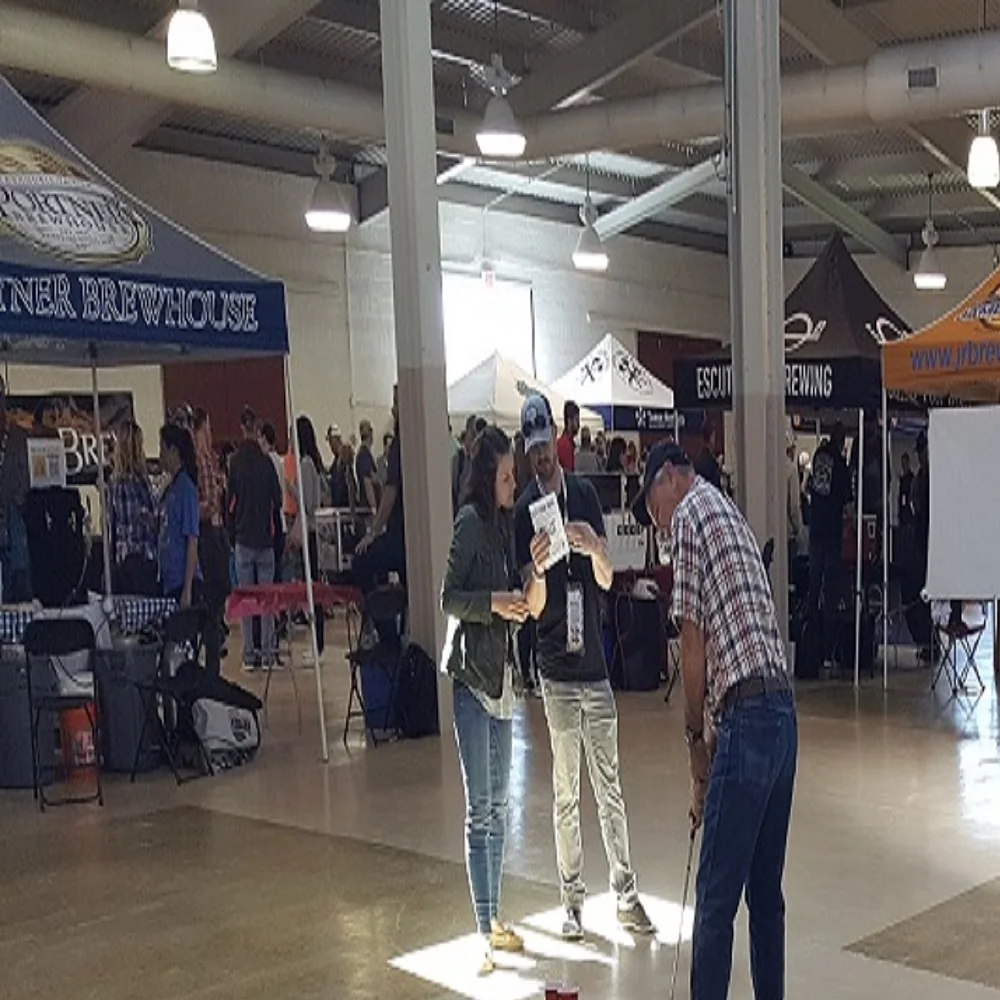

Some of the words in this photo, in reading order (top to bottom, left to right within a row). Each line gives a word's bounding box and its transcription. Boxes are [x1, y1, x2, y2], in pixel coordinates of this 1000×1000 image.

[79, 276, 259, 333] BREWHOUSE
[696, 364, 732, 400] ESCUT
[785, 363, 832, 398] REWING
[58, 427, 117, 476] BRE
